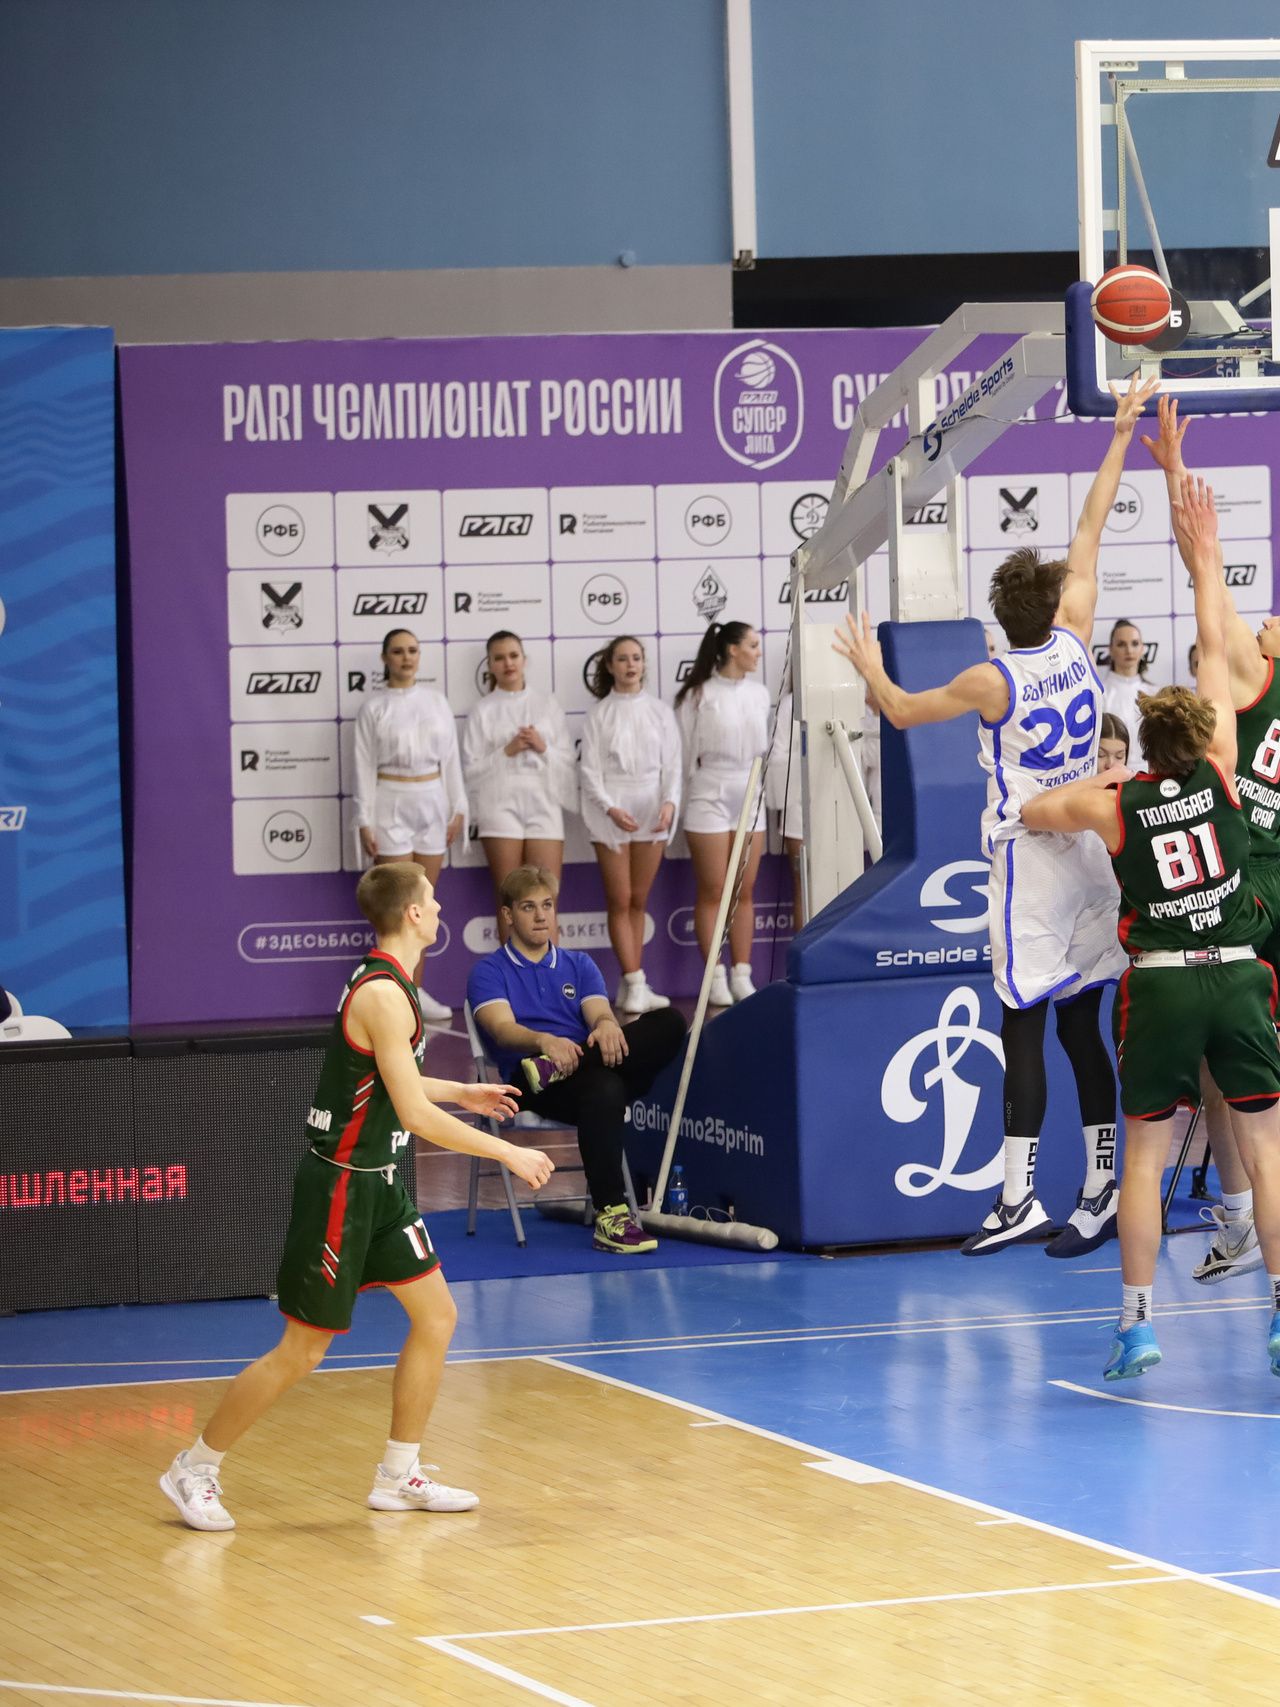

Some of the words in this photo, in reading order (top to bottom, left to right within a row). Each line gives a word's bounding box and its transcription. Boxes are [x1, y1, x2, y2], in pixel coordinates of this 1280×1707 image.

[940, 389, 980, 429] Schelde
[980, 357, 1014, 397] Sports
[222, 384, 302, 442] PARI
[312, 380, 531, 440] ЧЕМПИОНАТ
[541, 377, 683, 436] РОССИИ
[732, 405, 787, 434] СУПЕР
[1113, 501, 1137, 514] ФБ
[262, 523, 298, 538] РФБ
[461, 516, 532, 536] PARI
[691, 513, 726, 528] РФБ
[354, 594, 426, 615] PARI
[587, 592, 622, 607] РФБ
[248, 672, 320, 693] PARI
[1019, 688, 1095, 771] 29
[1136, 787, 1215, 829] ТЮЛЮБАЕВ
[1250, 805, 1276, 830] КРАЙ
[269, 829, 305, 843] РФБ
[1150, 821, 1226, 891] 81
[1148, 867, 1242, 919] КРАСНОДАРСКИЙ
[1188, 906, 1223, 933] КРАЙ
[875, 946, 978, 967] Schelde
[632, 1100, 765, 1157] @dinmo25prim
